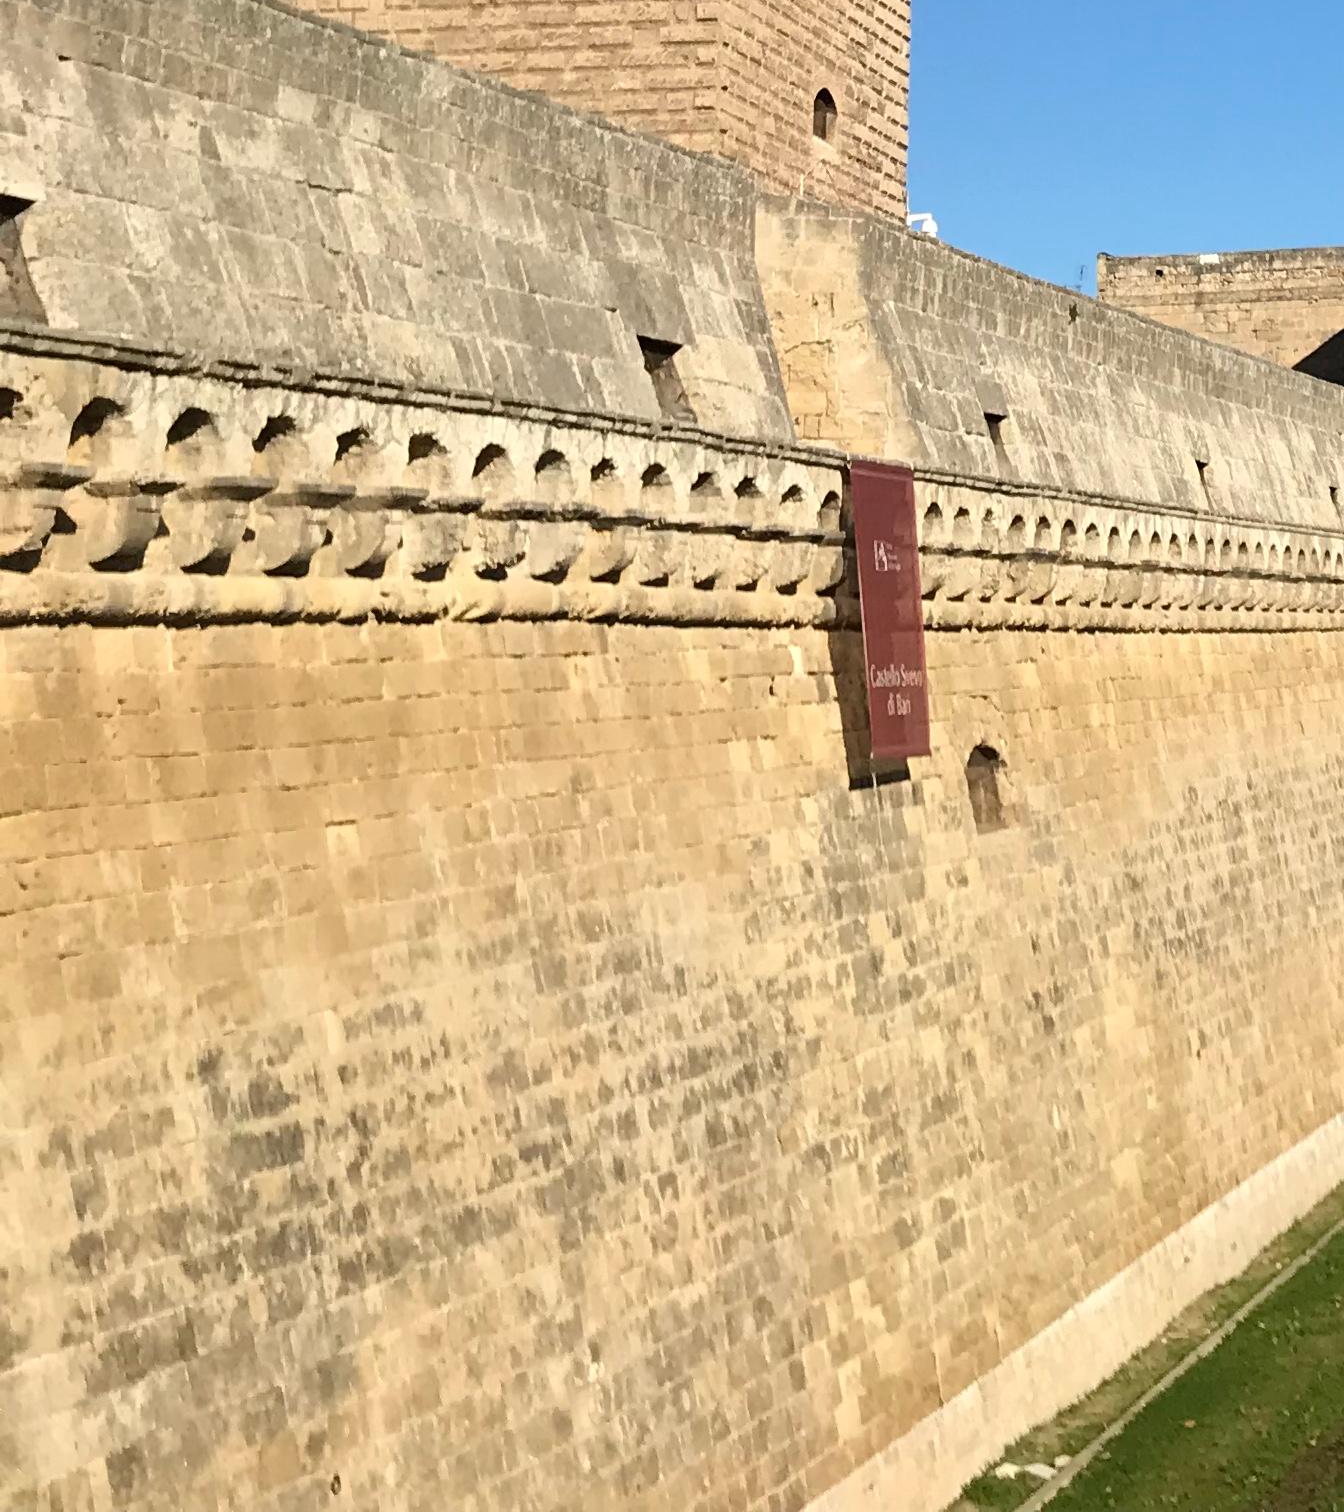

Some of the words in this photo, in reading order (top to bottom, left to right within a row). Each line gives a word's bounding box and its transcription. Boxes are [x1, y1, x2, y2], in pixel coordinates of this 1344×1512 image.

[870, 664, 900, 688] Castello
[900, 663, 922, 687] Svevo
[887, 692, 895, 715] di
[896, 693, 911, 715] Bari
